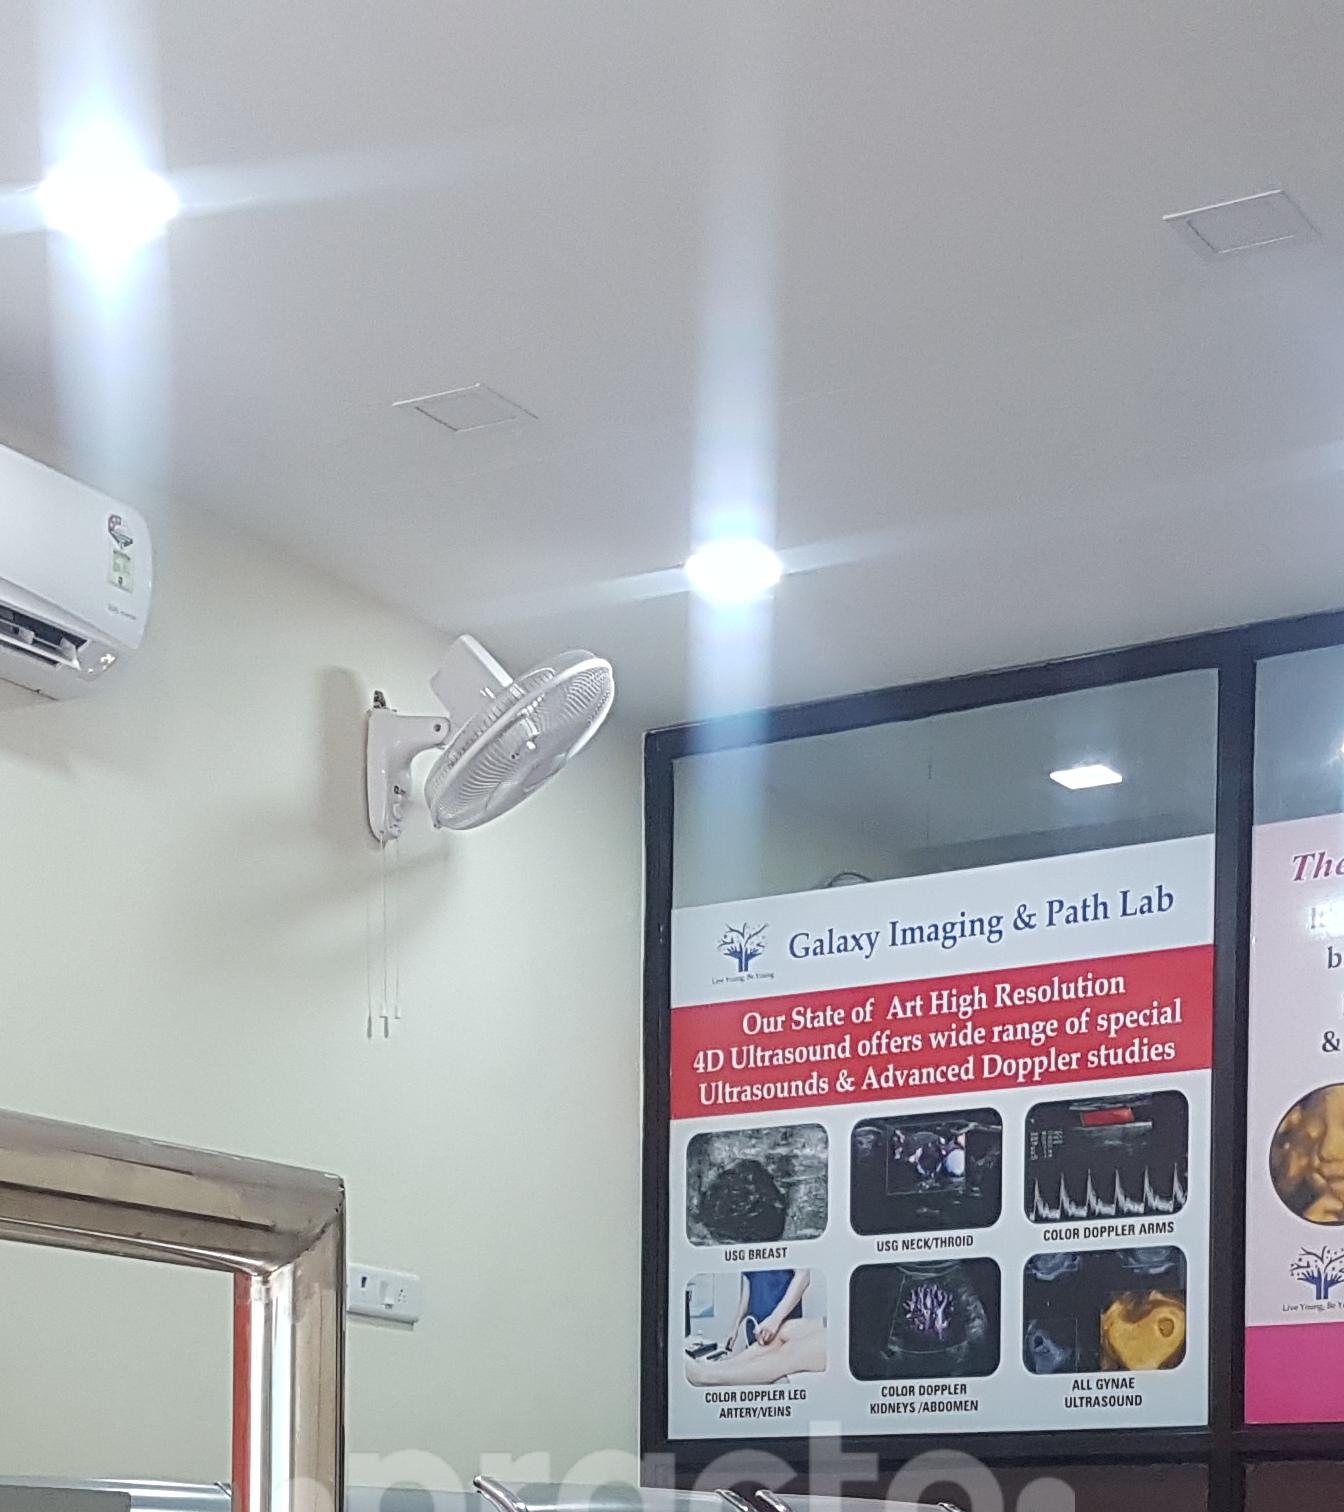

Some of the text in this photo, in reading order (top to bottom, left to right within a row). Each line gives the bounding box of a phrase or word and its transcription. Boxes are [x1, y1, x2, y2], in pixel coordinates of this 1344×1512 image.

[788, 884, 1174, 960] Galaxy Imaging & Path Lab
[743, 972, 1125, 1035] Our State of Art High Resolution
[693, 998, 1182, 1075] 4D Ultrasound offers wide range of special
[1322, 1030, 1340, 1053] &
[699, 1036, 1176, 1105] Ultrasounds & Advanced Doppler studies
[1043, 1221, 1175, 1241] COLOR DOPPLER ARMS
[876, 1234, 974, 1252] USG NECK/THROID
[724, 1247, 788, 1262] USG BREAST
[881, 1383, 967, 1398] COLOR DOPPLER
[1072, 1377, 1135, 1392] ALL GYNAE
[705, 1388, 807, 1403] COLOR DOPPLER LEG
[1064, 1394, 1142, 1409] ULTRASOUND
[719, 1405, 791, 1419] ARTERY/VEINS
[870, 1401, 915, 1414] KIDNEYS
